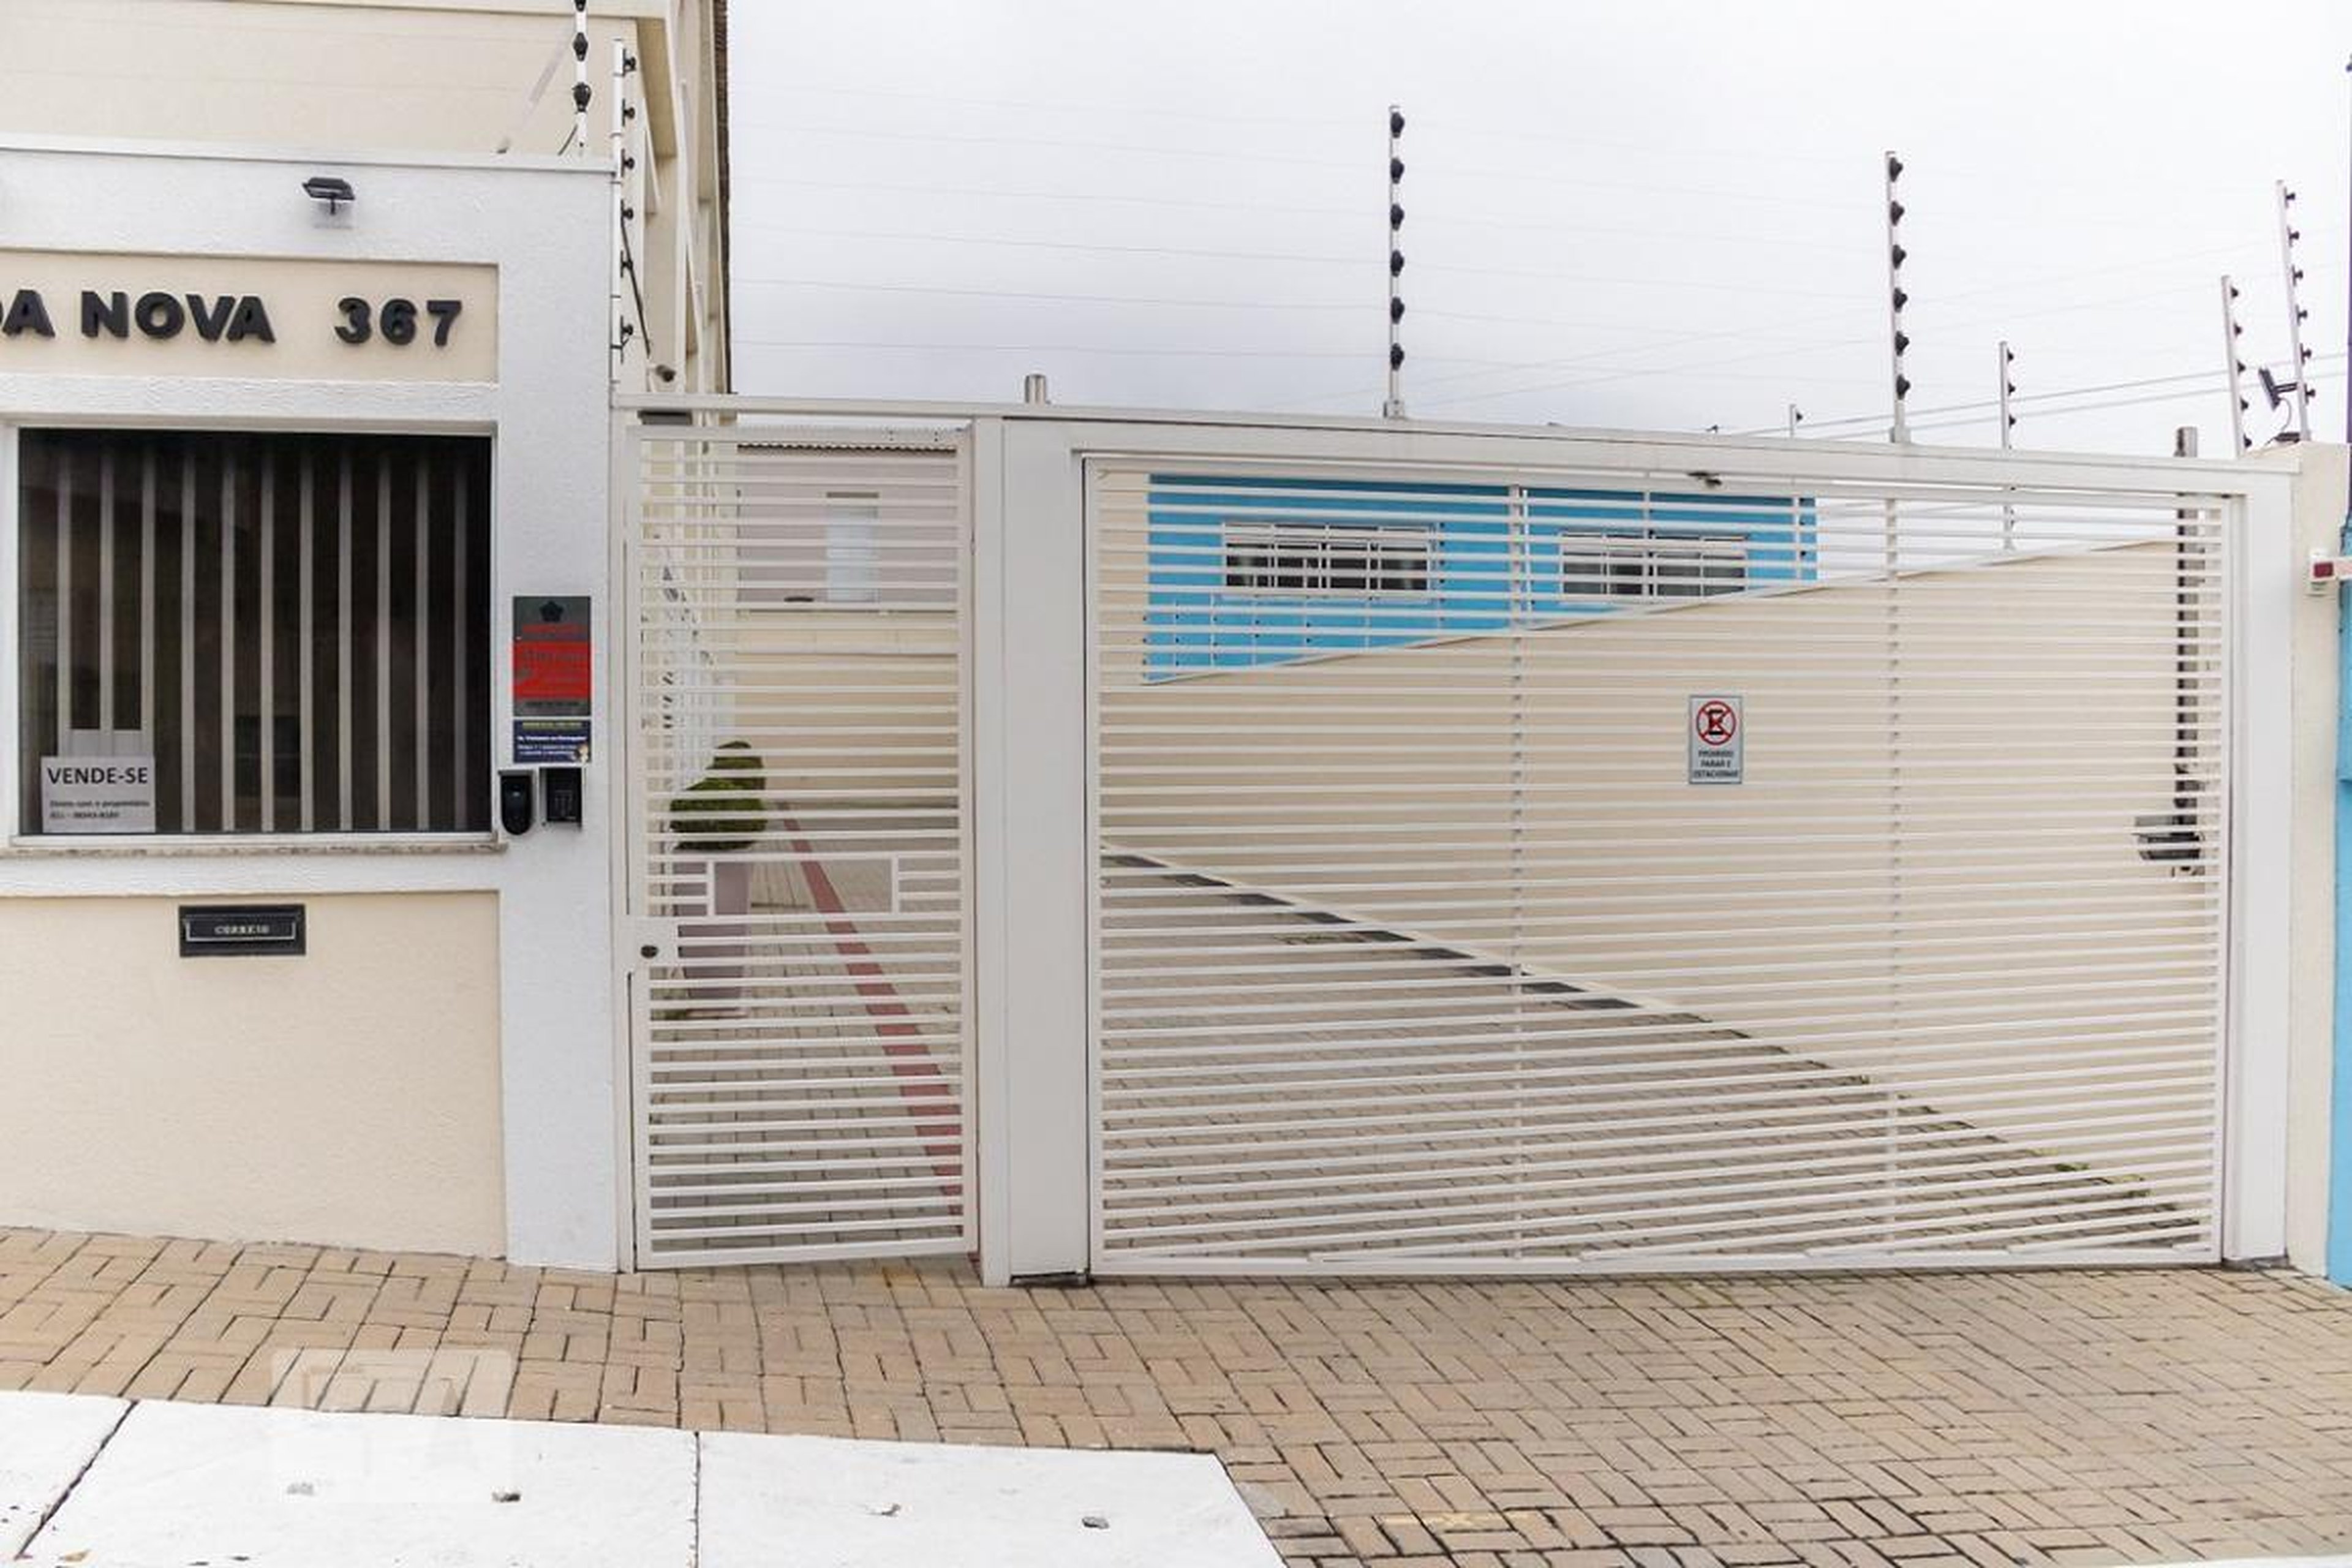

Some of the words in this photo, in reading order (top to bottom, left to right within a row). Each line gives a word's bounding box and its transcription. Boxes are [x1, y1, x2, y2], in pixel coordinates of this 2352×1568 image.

[0, 290, 55, 337] A
[81, 291, 276, 342] NOVA
[334, 296, 462, 347] 367
[1700, 759, 1725, 767] PARAR
[47, 767, 148, 784] VENDE-SE
